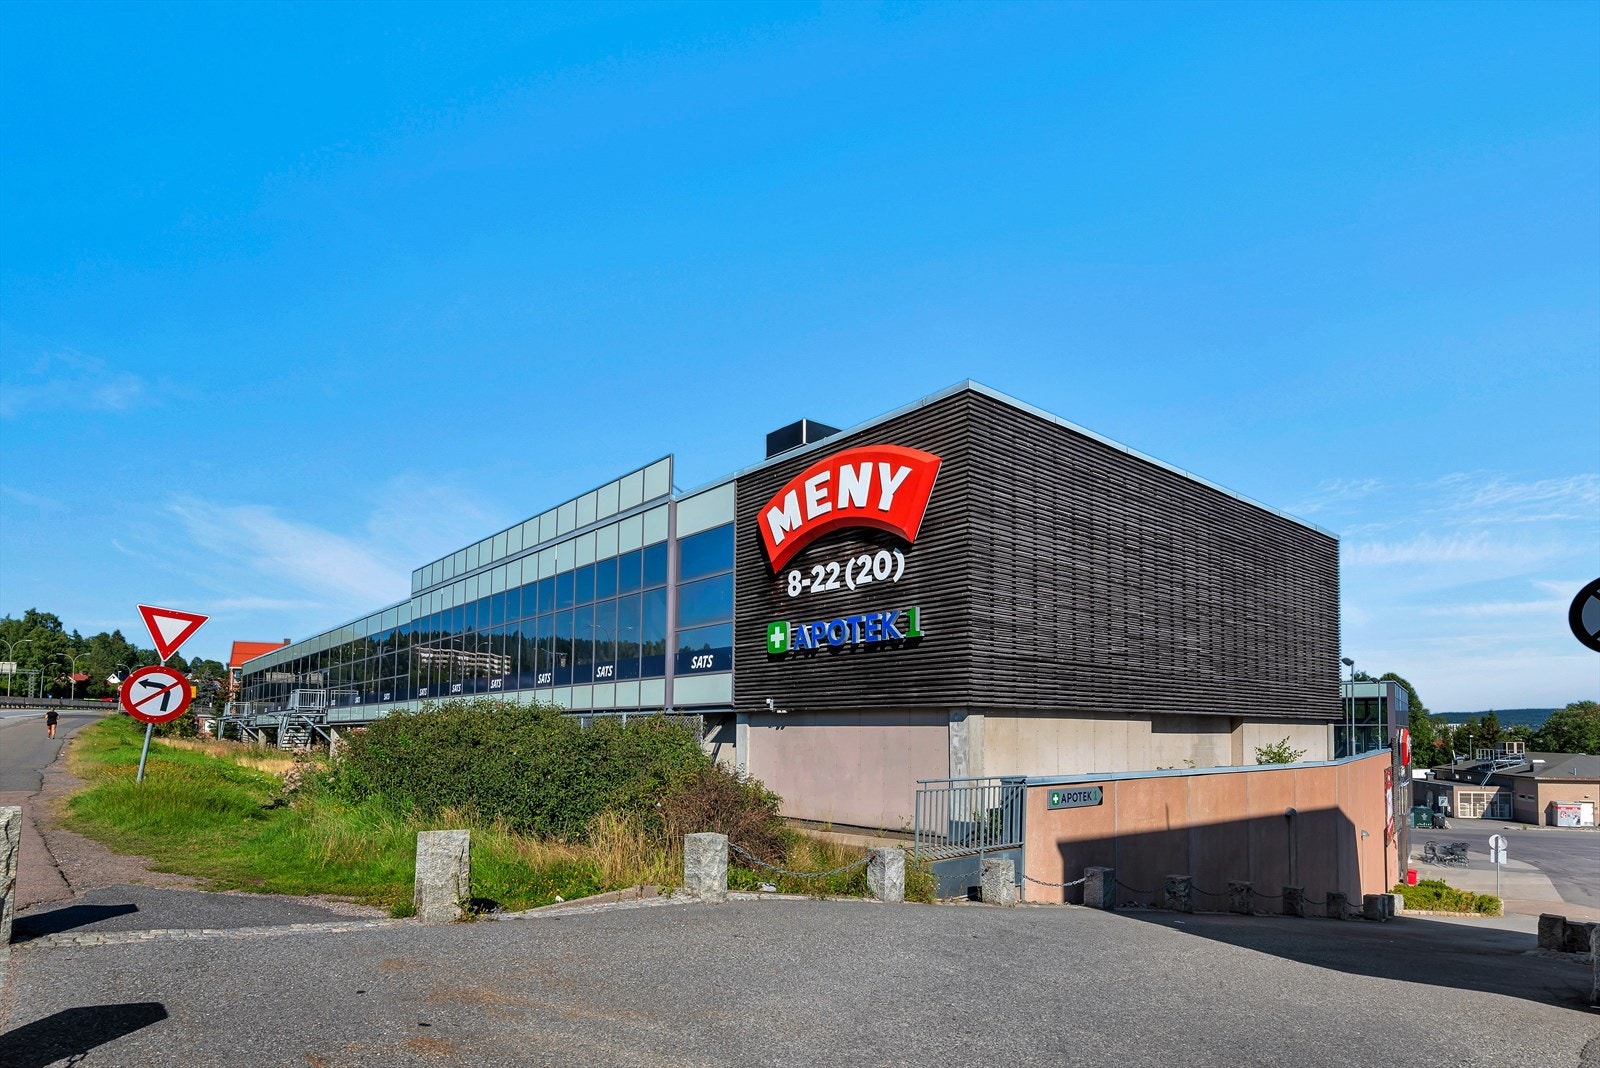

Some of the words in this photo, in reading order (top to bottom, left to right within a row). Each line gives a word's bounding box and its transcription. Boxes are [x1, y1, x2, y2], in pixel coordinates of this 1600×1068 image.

[766, 461, 913, 546] MENY
[787, 561, 841, 598] 8-22
[845, 548, 906, 591] (20)
[793, 609, 902, 650] APOTEK
[691, 654, 713, 669] SATS
[537, 673, 551, 684] SATS
[596, 665, 613, 678] SATS
[490, 679, 502, 689] SATS
[1061, 791, 1092, 803] APOTEK
